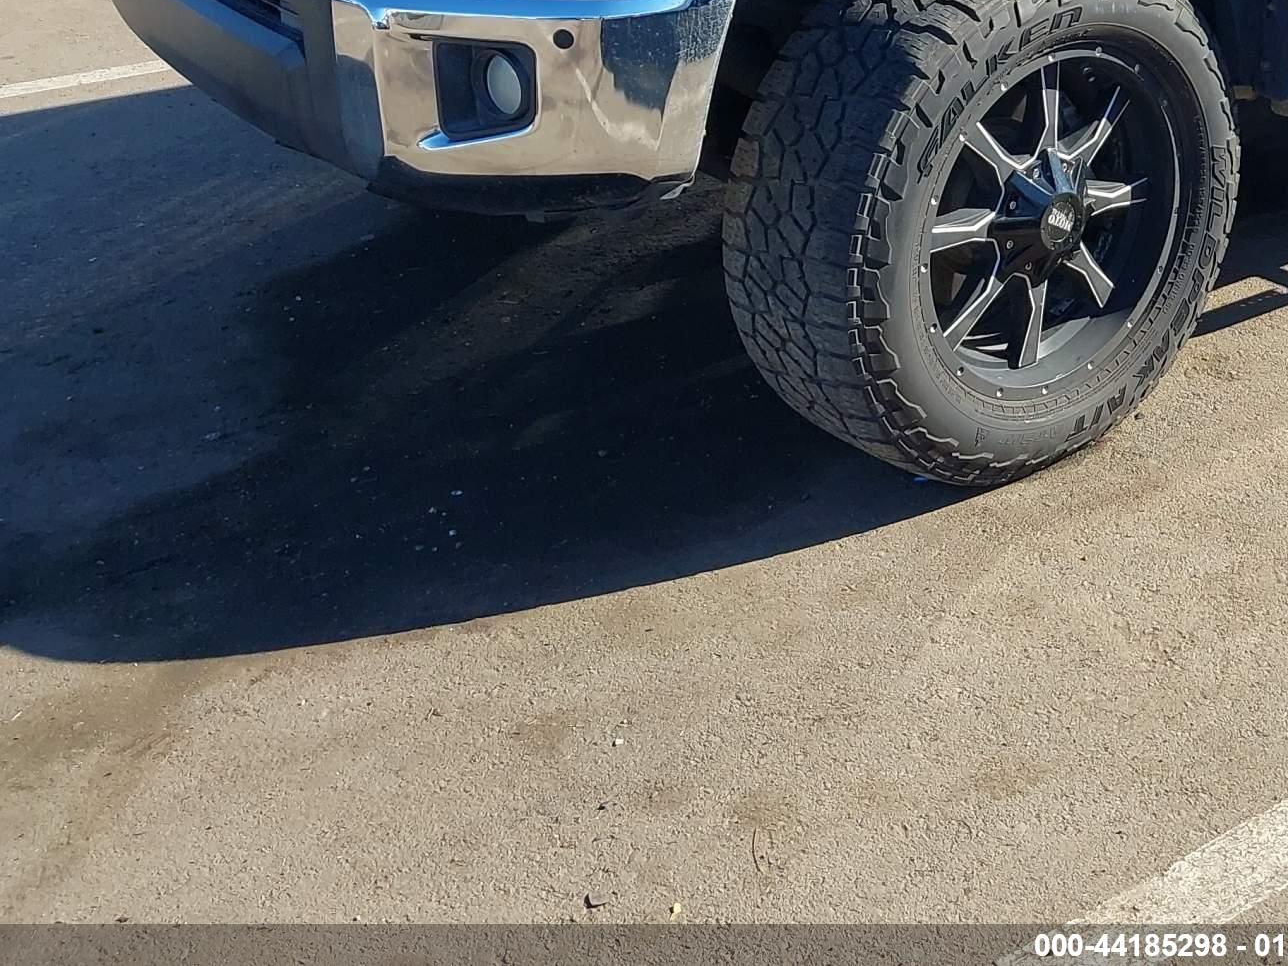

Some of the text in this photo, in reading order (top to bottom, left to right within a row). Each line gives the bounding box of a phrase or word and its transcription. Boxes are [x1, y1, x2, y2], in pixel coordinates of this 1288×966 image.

[916, 6, 1084, 183] FALKEN
[1132, 145, 1227, 392] WILDPEAK
[1065, 384, 1128, 442] A/T
